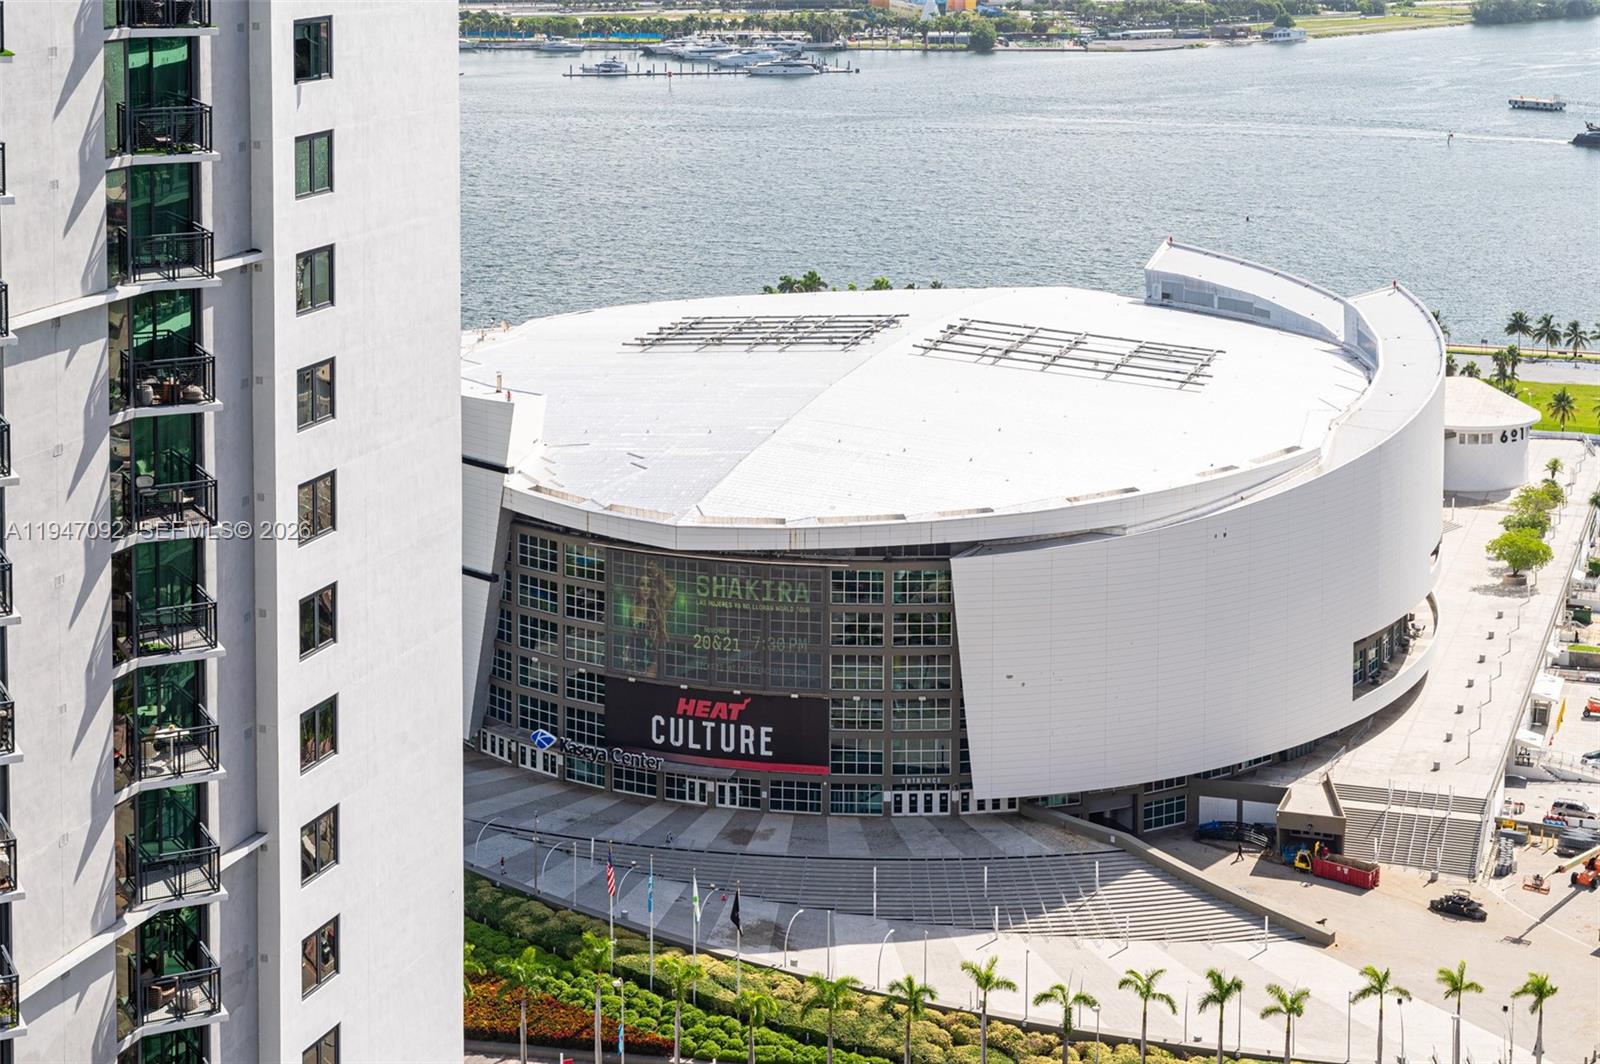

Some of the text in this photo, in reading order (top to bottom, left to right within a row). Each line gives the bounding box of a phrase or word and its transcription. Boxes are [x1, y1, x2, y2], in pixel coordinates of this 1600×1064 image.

[696, 575, 811, 604] SHAKIRA
[693, 633, 742, 652] 20&21
[676, 697, 752, 721] HEAT
[651, 714, 774, 756] CULTURE
[560, 736, 665, 770] Kaseya Center
